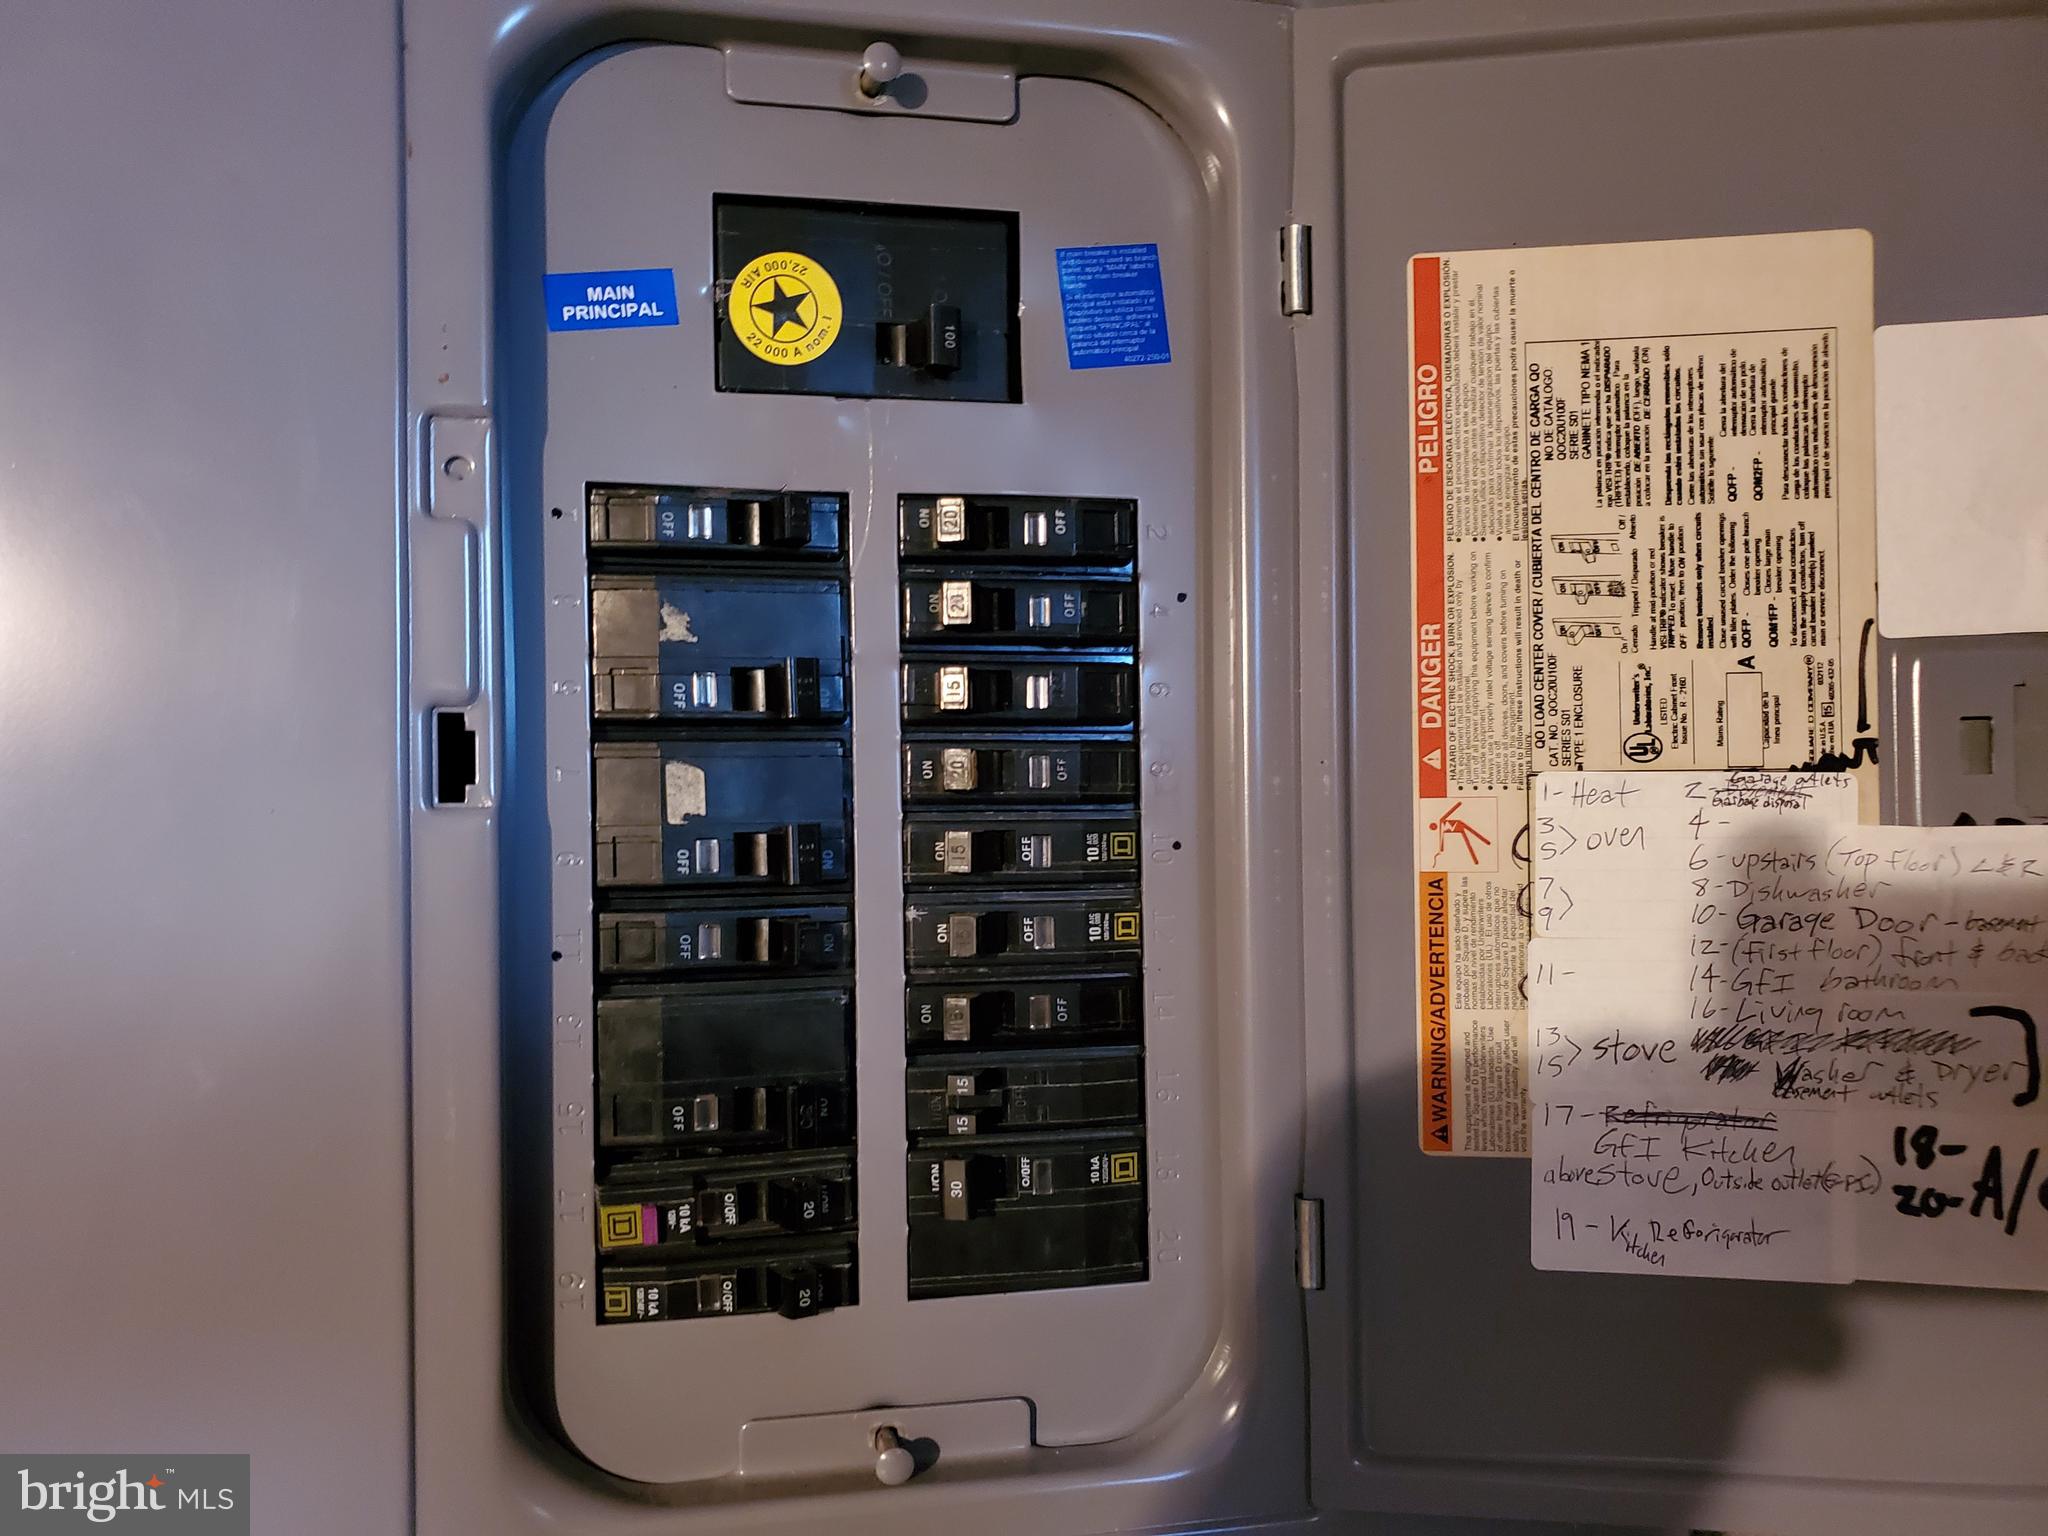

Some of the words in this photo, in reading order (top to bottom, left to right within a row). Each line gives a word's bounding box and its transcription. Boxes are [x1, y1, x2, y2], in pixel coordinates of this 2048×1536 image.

[742, 266, 761, 289] AIR
[765, 259, 808, 276] 22,000
[586, 284, 635, 301] MAIN
[562, 302, 664, 321] PRINCIPAL
[746, 331, 762, 347] 22
[765, 343, 788, 358] 000
[793, 347, 802, 357] A
[945, 325, 956, 348] 100
[1529, 362, 1540, 381] QO
[1581, 349, 1590, 378] NEMA
[1581, 381, 1591, 404] TIPO
[1529, 384, 1541, 427] CARGA
[1418, 364, 1439, 474] PELIGRO
[1556, 397, 1567, 460] QOC20U100F
[1569, 410, 1578, 426] S01
[1530, 430, 1541, 446] DE
[1569, 429, 1579, 459] SERIE
[1581, 408, 1591, 459] GABINETE
[1530, 449, 1542, 498] CENTRO
[1727, 473, 1737, 502] QOFP
[661, 511, 675, 538] OFF
[919, 509, 929, 528] ON
[943, 511, 957, 529] 20
[1055, 509, 1066, 535] OFF
[1531, 501, 1542, 524] DEL
[1531, 527, 1543, 587] CUBIERTA
[1447, 552, 1455, 604] EXPLOSION.
[929, 594, 939, 613] ON
[950, 594, 963, 612] 20
[1064, 593, 1075, 618] OFF
[1447, 607, 1455, 620] OR
[1532, 598, 1543, 640] COVER
[1448, 622, 1456, 646] BURN
[1741, 619, 1752, 648] QOFP
[1533, 643, 1545, 690] CENTER
[1738, 655, 1755, 669] A
[1421, 623, 1441, 729] DANGER
[1547, 652, 1558, 716] QOC20U100F
[673, 683, 687, 709] OFF
[946, 681, 960, 697] 15
[1573, 664, 1583, 728] ENCLOSURE
[1448, 684, 1457, 727] ELECTRIC
[1534, 694, 1545, 726] LOAD
[1561, 709, 1571, 726] S01
[1449, 730, 1457, 742] OF
[1534, 730, 1546, 748] QO
[1561, 728, 1571, 766] SERIES
[1449, 744, 1457, 780] HAZARD
[1549, 743, 1558, 766] CAT.
[1574, 739, 1584, 766] TYPE
[922, 760, 933, 779] ON
[950, 760, 965, 778] 20
[1056, 758, 1067, 781] OFF
[1571, 778, 1641, 808] Heat
[1538, 817, 1555, 834] 3
[934, 841, 945, 861] ON
[951, 846, 966, 860] 15
[1021, 836, 1031, 861] OFF
[1540, 843, 1557, 860] 5
[1587, 826, 1645, 850] oven
[677, 849, 690, 875] OFF
[822, 849, 834, 869] ON
[1732, 850, 1816, 880] upstairs
[1539, 877, 1555, 899] 7
[1727, 876, 1891, 903] Dishwasher
[1023, 917, 1034, 942] OFF
[1538, 906, 1553, 930] 9
[1736, 902, 1835, 938] Garage
[1850, 906, 1938, 932] Door
[937, 923, 948, 943] ON
[680, 934, 692, 959] OFF
[1820, 965, 1958, 993] bathroom
[1057, 998, 1068, 1021] OFF
[1428, 878, 1448, 1122] WARNING/ADVERTENCIA
[921, 1004, 931, 1023] ON
[1735, 997, 1823, 1032] Living
[1838, 1002, 1905, 1021] room
[1537, 1027, 1561, 1047] 13
[1538, 1054, 1564, 1077] 15
[1593, 1029, 1678, 1064] stove
[957, 1078, 969, 1094] 15
[1775, 1056, 1884, 1082] Washer
[1932, 1060, 2027, 1095] Dryer
[672, 1106, 684, 1131] OFF
[957, 1116, 969, 1133] 15
[1594, 1128, 1662, 1161] GFI
[1680, 1136, 1795, 1170] Kitchen
[1090, 1155, 1100, 1171] kA
[1090, 1171, 1100, 1183] 10
[951, 1181, 962, 1198] 30
[679, 1204, 691, 1217] 10
[725, 1193, 737, 1225] O/OFF
[803, 1201, 814, 1219] 20
[679, 1218, 691, 1233] kA
[648, 1287, 659, 1299] 10
[722, 1281, 734, 1312] O/OFF
[799, 1288, 811, 1307] 20
[648, 1301, 659, 1316] kA
